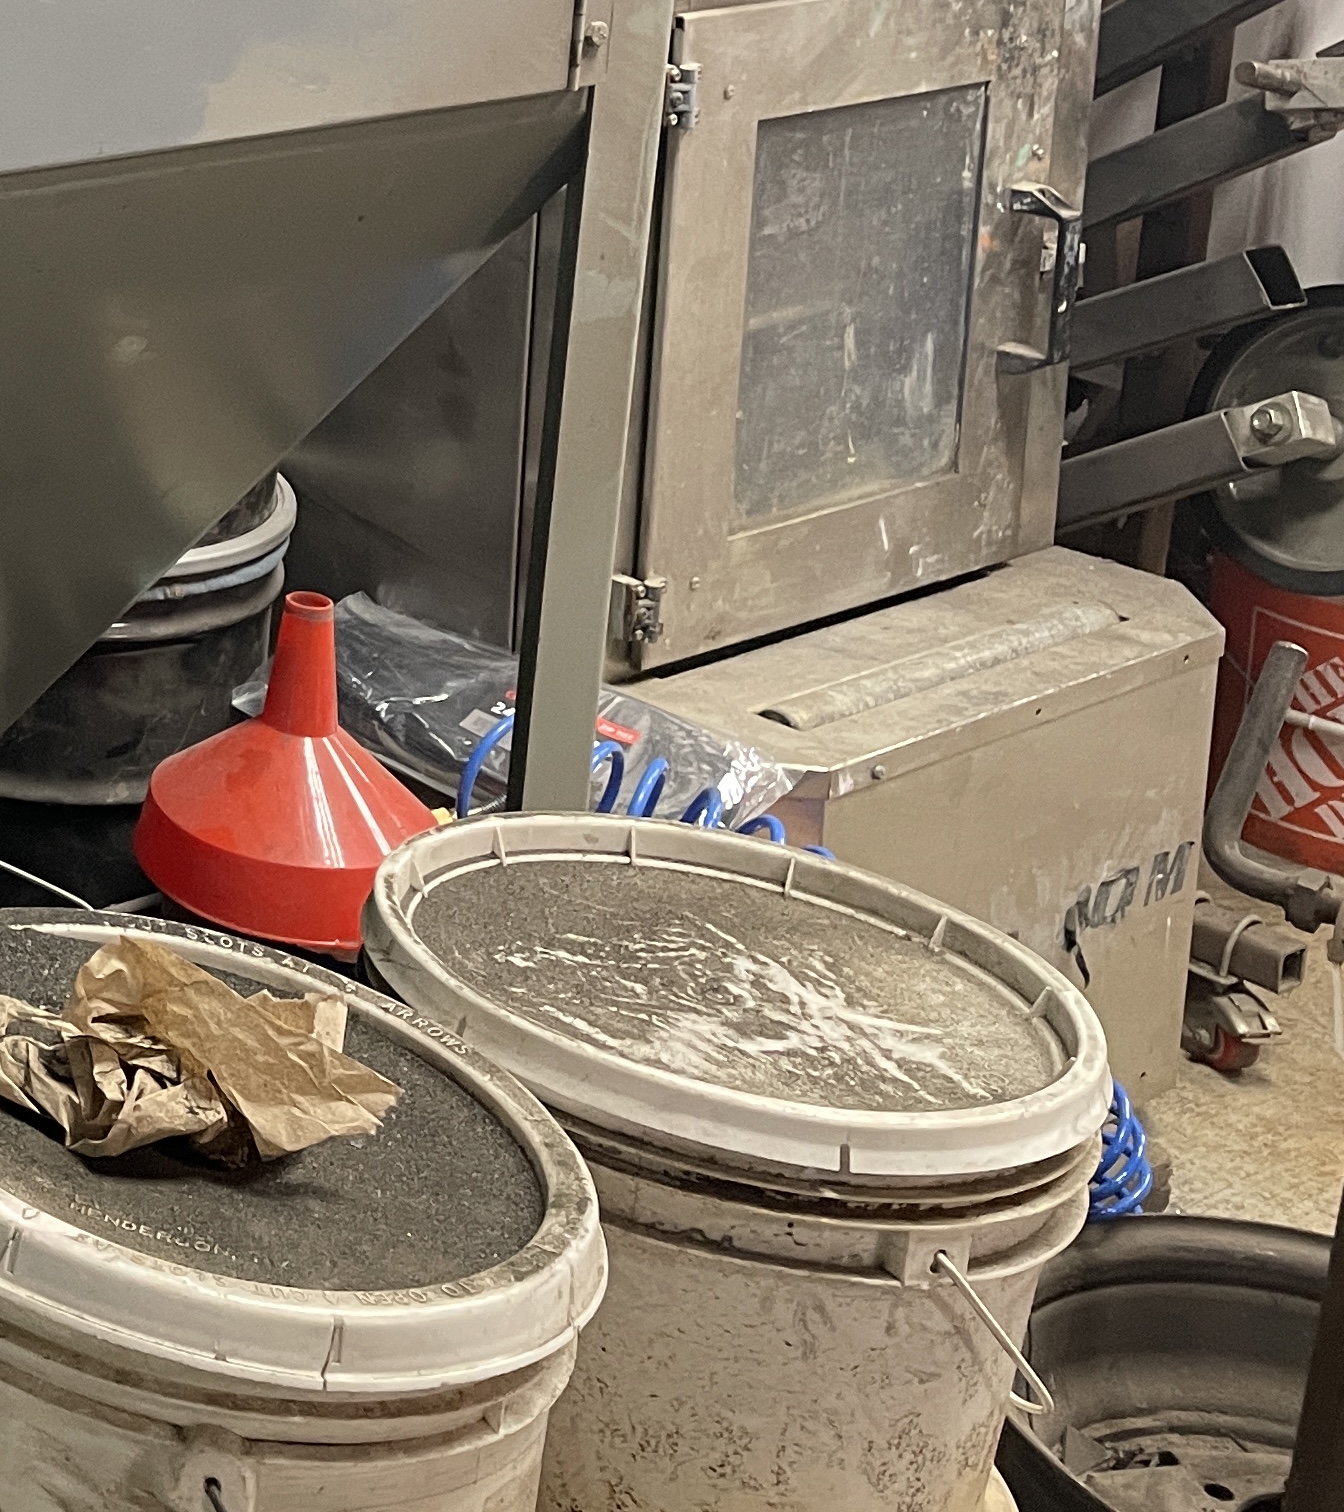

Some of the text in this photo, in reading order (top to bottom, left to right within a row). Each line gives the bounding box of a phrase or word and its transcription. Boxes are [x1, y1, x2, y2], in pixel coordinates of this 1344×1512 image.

[185, 925, 265, 958] SLOTS
[380, 1000, 471, 1057] ARROWS
[353, 1288, 429, 1307] OPEN
